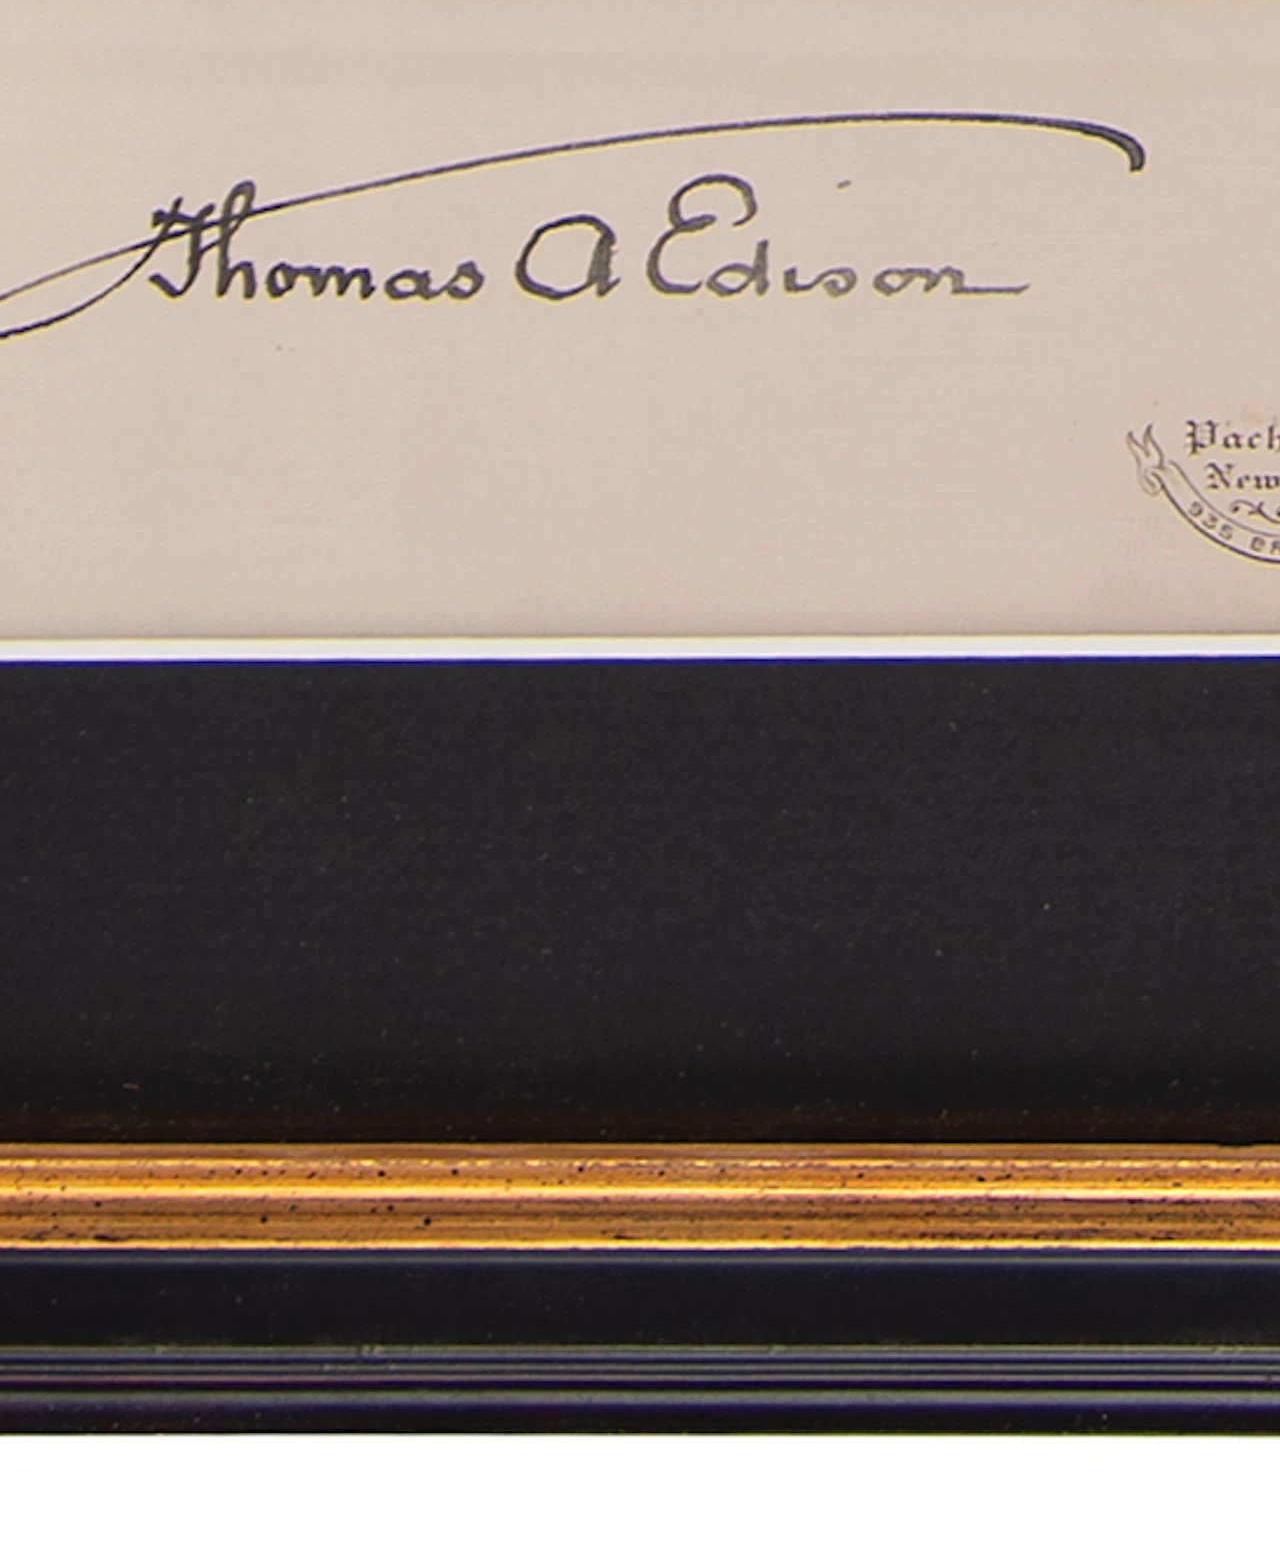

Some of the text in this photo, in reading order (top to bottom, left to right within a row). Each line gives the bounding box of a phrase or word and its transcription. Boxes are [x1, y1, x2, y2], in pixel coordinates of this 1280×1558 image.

[516, 215, 620, 300] A
[647, 175, 1028, 297] Edison
[1204, 462, 1280, 492] New
[1187, 500, 1235, 541] 935
